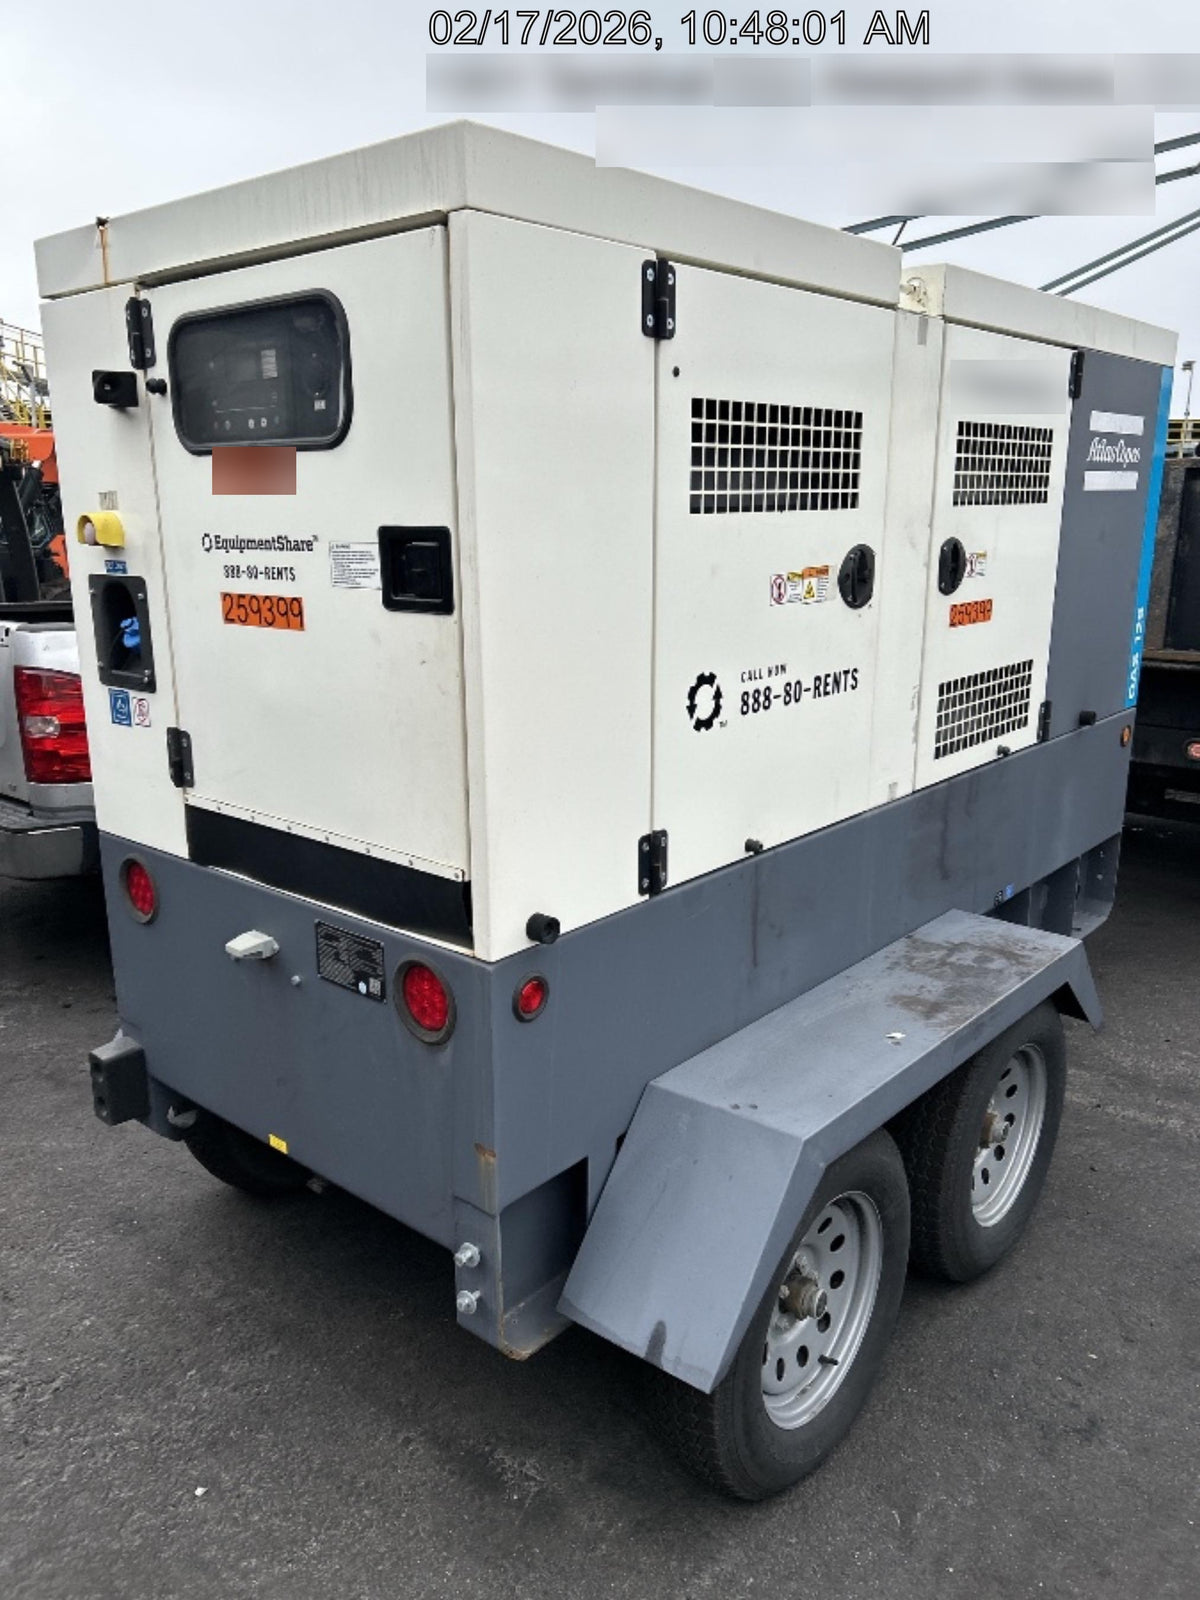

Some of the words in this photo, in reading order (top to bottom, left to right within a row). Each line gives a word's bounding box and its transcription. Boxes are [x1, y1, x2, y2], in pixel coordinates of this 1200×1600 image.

[223, 564, 296, 583] 888-80-RENTS
[223, 593, 304, 628] 259399
[740, 668, 763, 684] CALL
[740, 667, 859, 716] 888-80-RENTS
